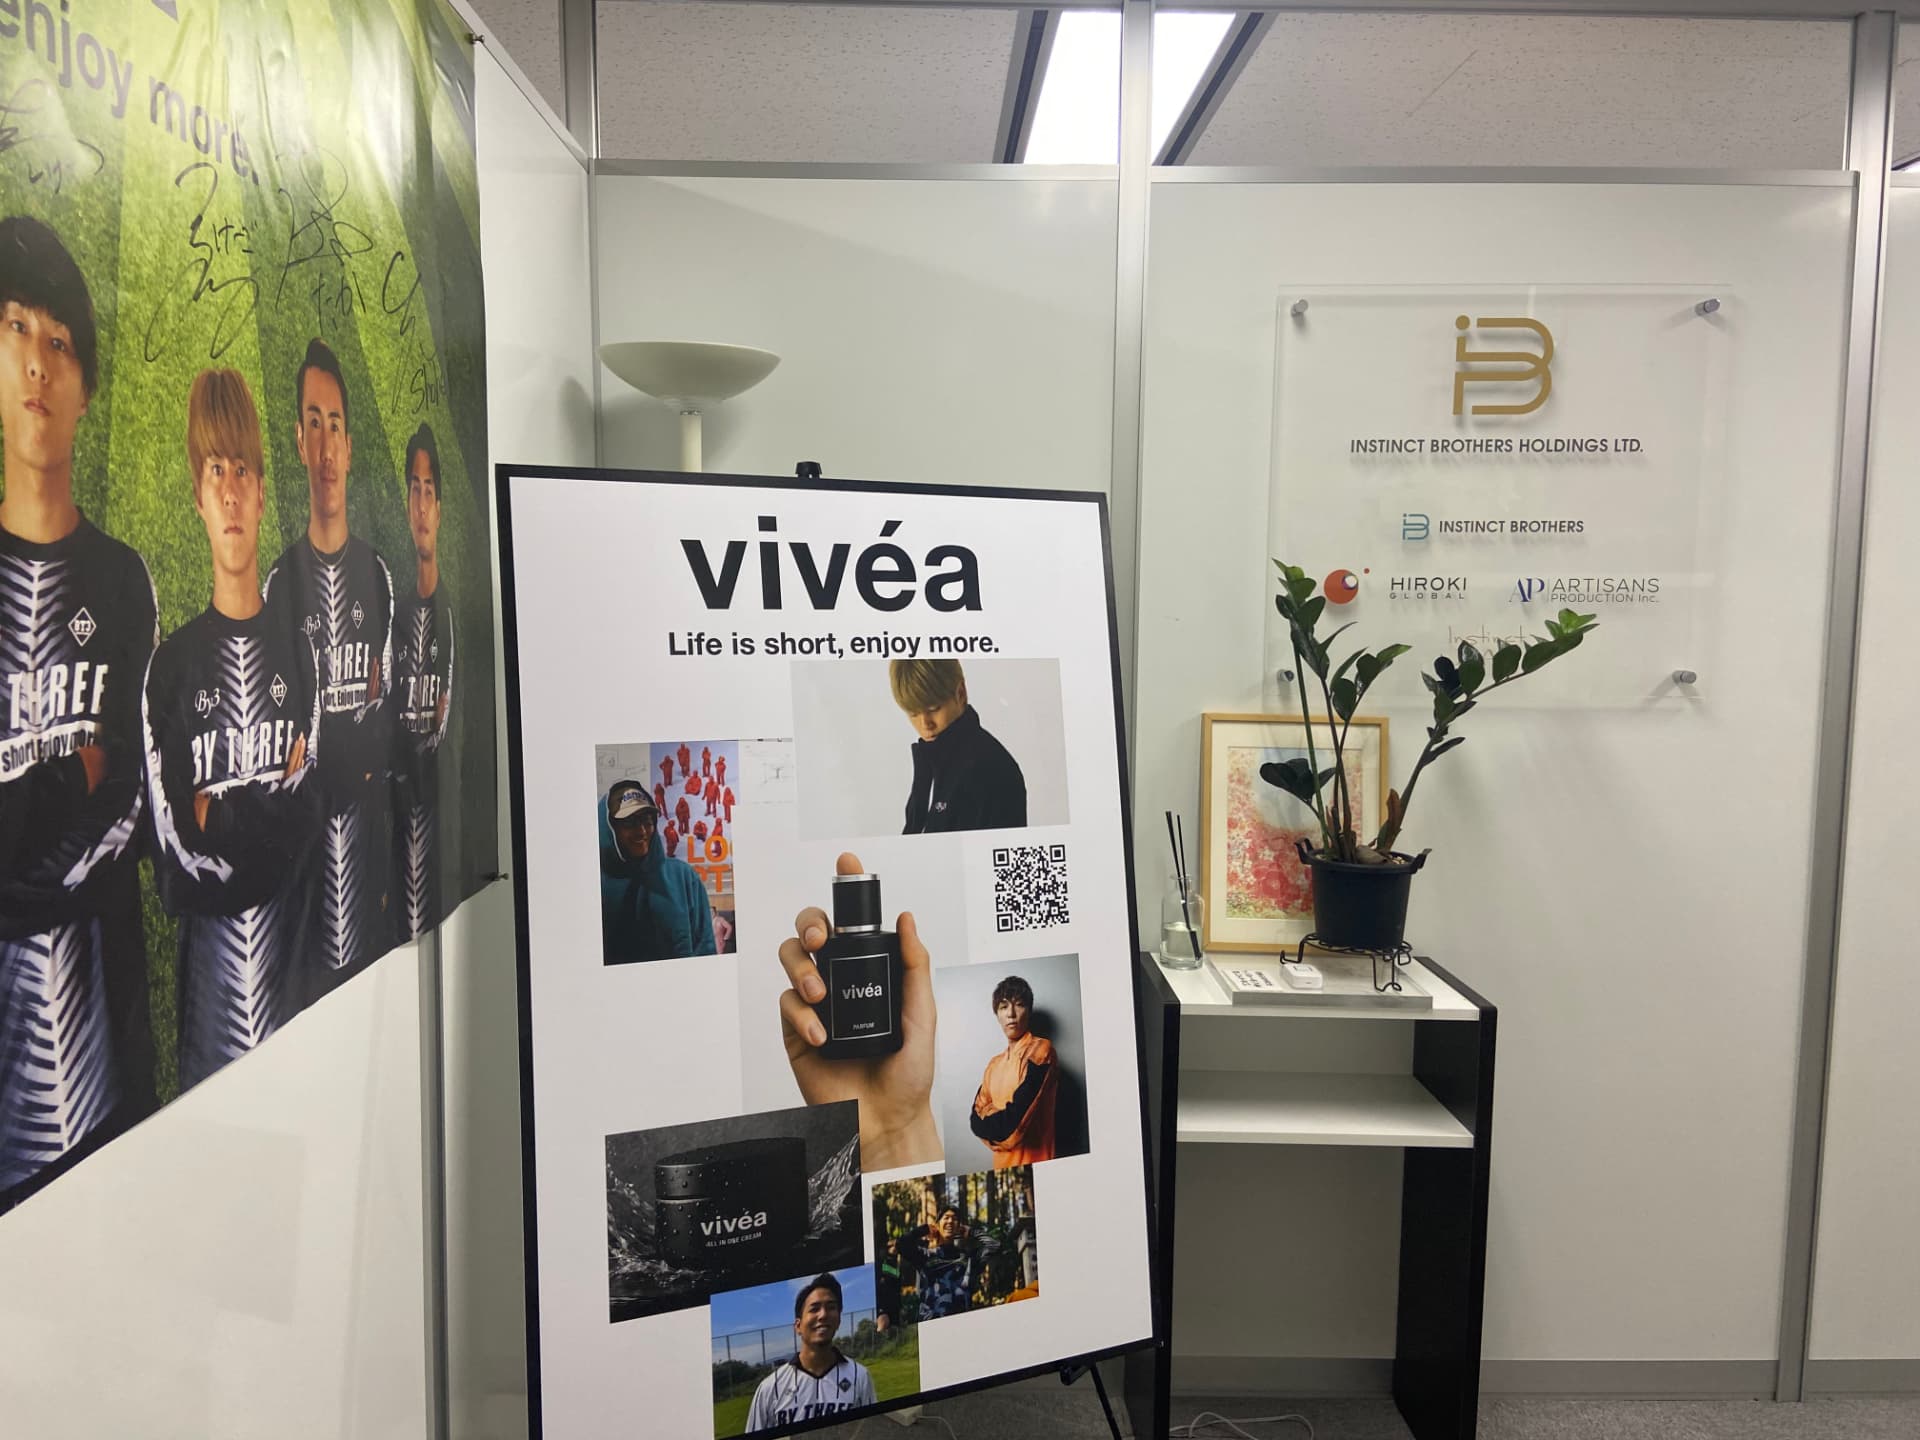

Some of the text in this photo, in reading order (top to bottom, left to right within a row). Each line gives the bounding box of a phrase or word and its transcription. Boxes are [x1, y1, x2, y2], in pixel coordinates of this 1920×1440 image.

[1350, 438, 1644, 453] INSTINCT BROTHERS HOLDINGS LTD.
[1439, 520, 1506, 533] INSTINCT
[1510, 520, 1584, 533] BROTHERS
[680, 515, 983, 613] vivéa
[1391, 577, 1467, 591] HIROKI
[1552, 578, 1660, 593] ARTISANS
[1389, 592, 1465, 600] GLOBAL
[1551, 593, 1634, 603] PRODUCTION
[669, 630, 1000, 659] Life is short, enjoy more.
[324, 641, 370, 682] HRE
[842, 982, 883, 1000] vivéa
[700, 1210, 767, 1236] vivéa
